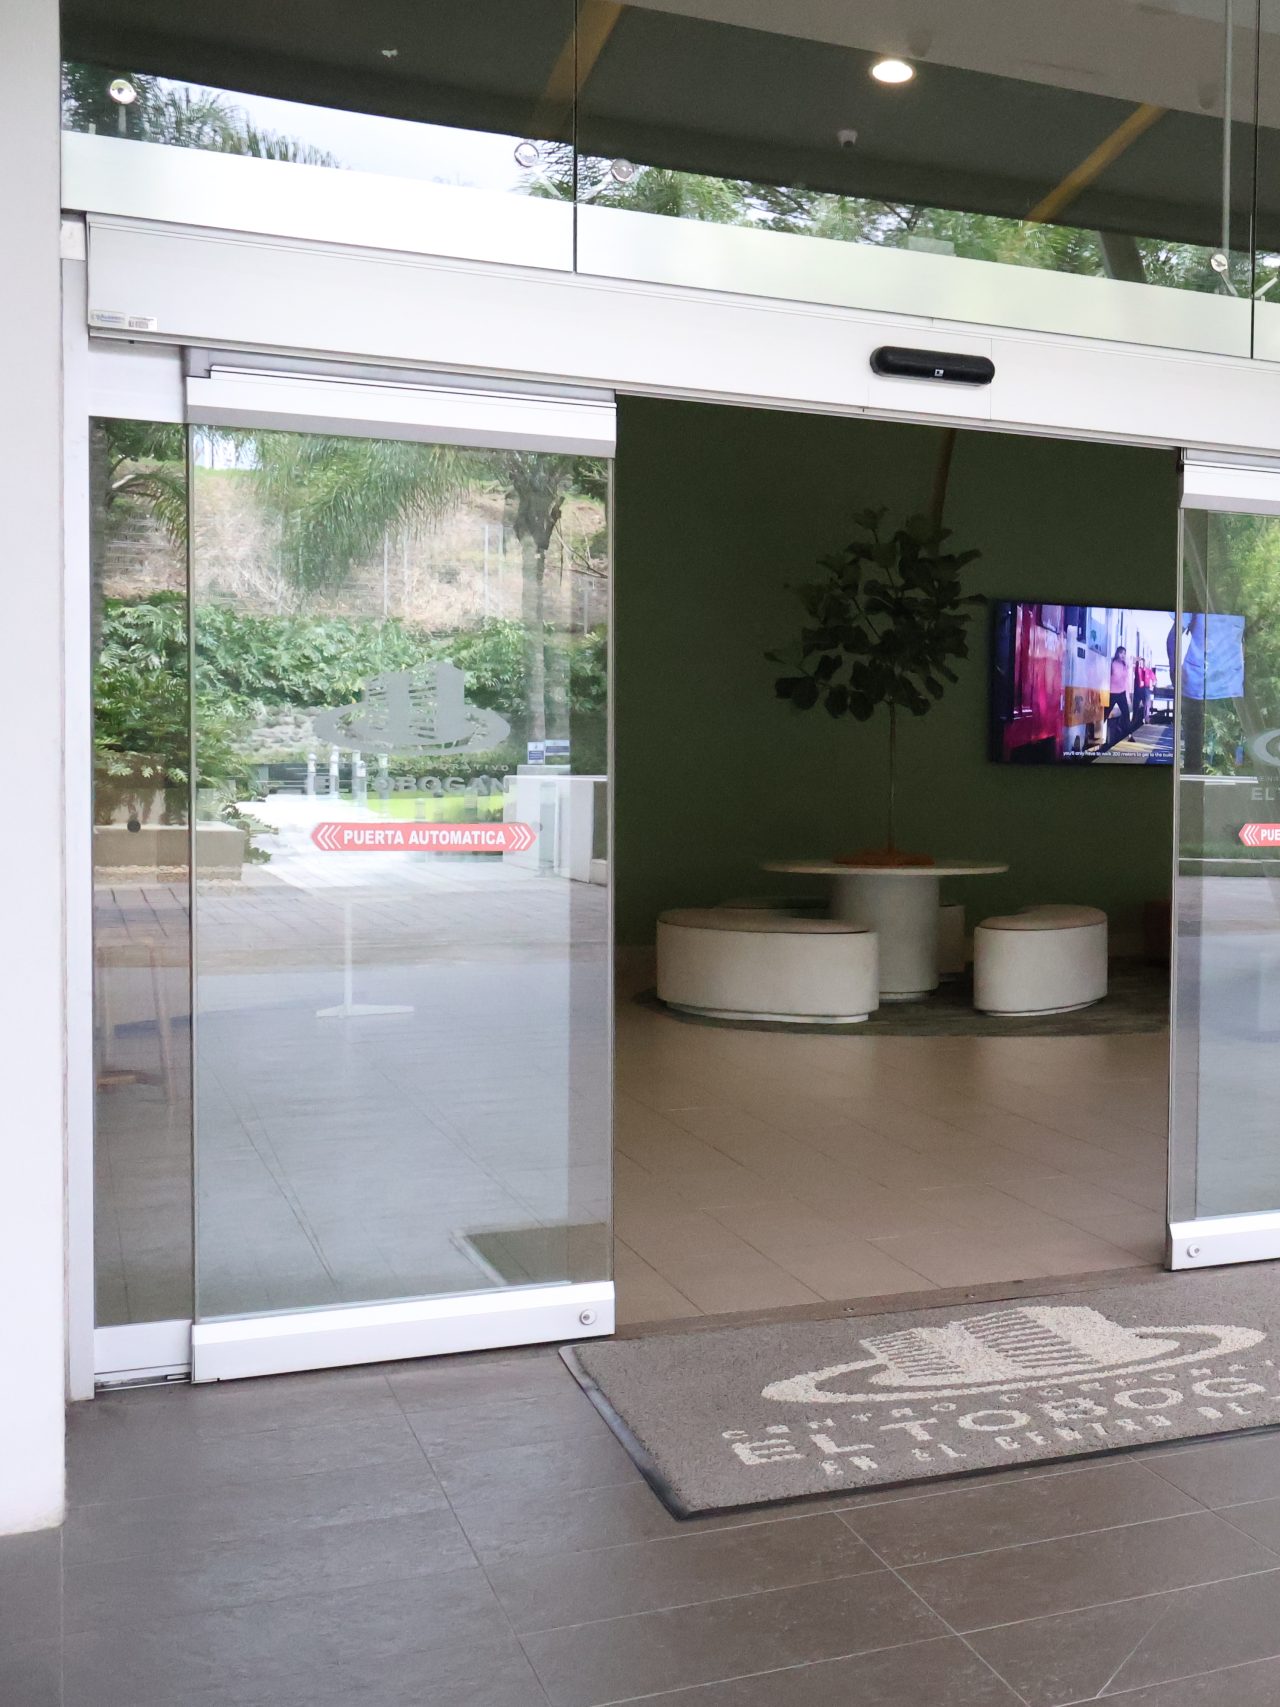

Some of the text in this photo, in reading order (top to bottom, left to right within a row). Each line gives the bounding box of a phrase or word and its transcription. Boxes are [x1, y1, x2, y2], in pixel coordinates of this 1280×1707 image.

[1251, 787, 1274, 801] EL
[343, 830, 506, 845] PUERTA AUTOMATICA
[731, 1433, 876, 1465] EL
